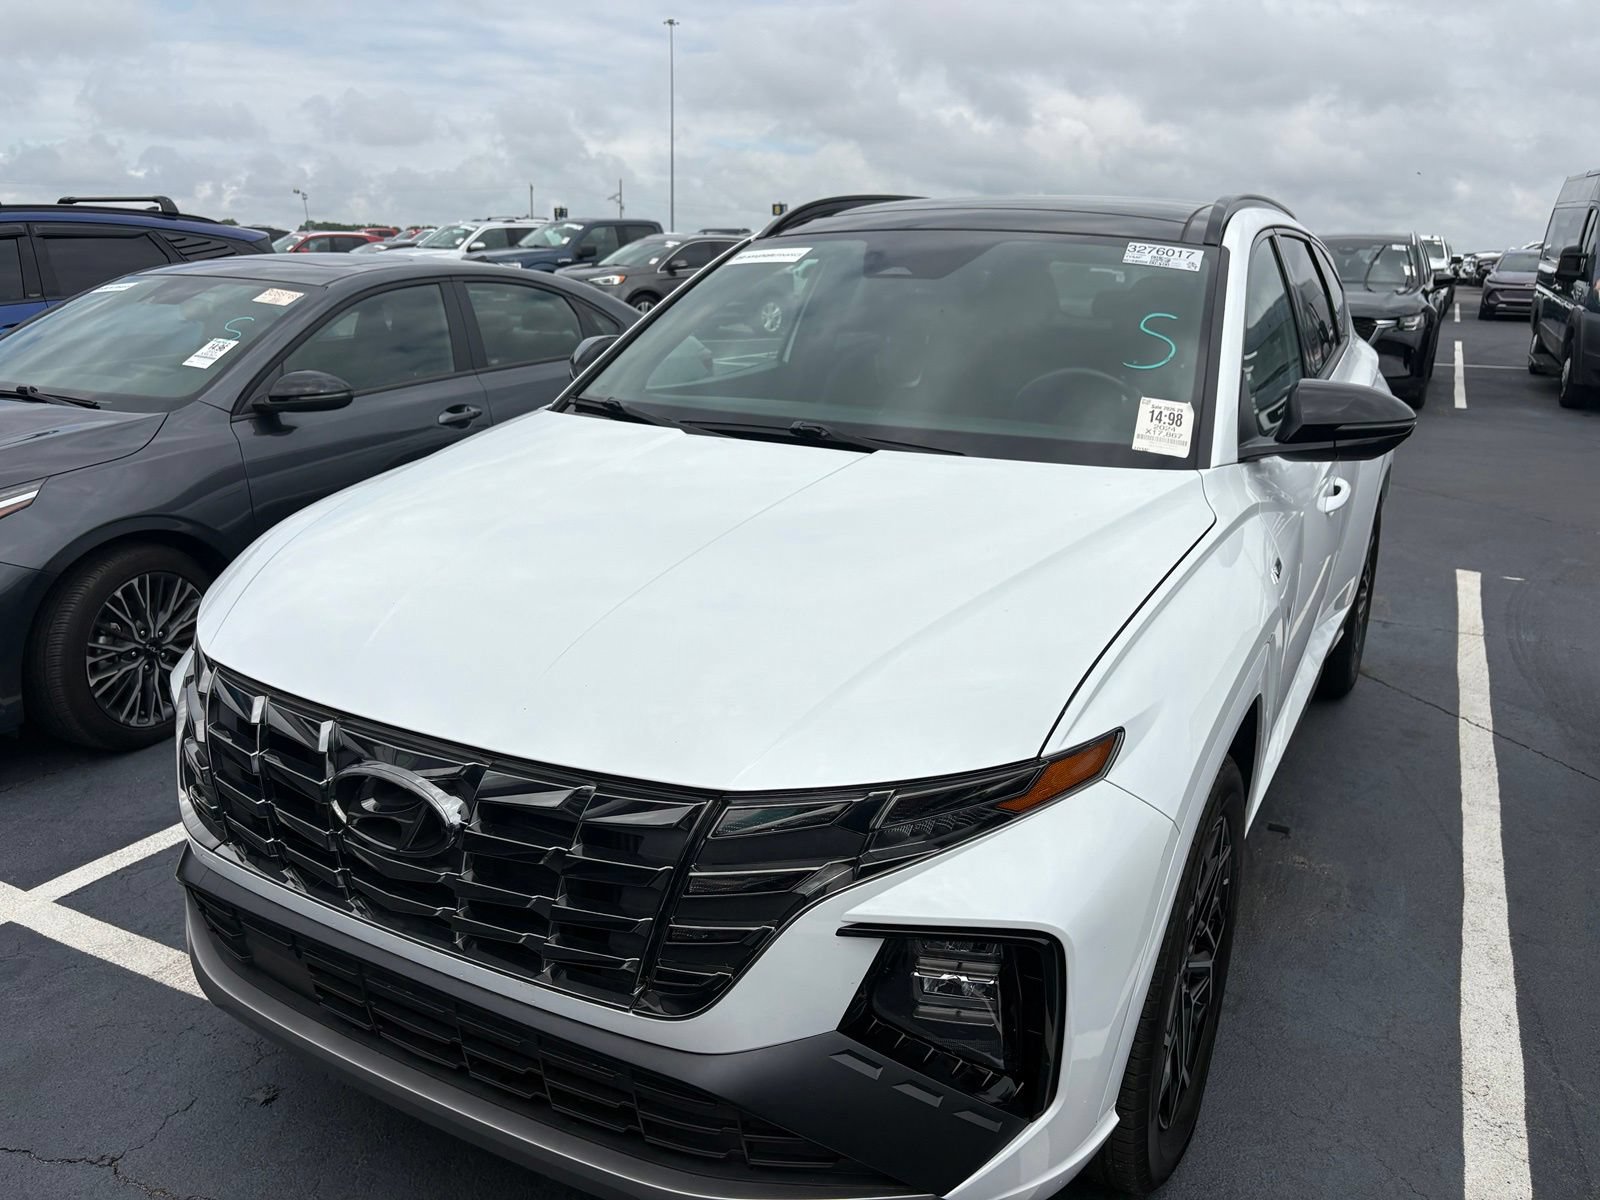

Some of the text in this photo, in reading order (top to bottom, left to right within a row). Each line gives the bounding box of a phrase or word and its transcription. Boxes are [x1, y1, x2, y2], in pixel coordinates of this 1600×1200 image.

[1128, 244, 1195, 260] 3276017
[208, 316, 255, 341] S
[1122, 312, 1178, 369] S
[1149, 409, 1184, 428] 14:98
[1153, 423, 1176, 433] 2024
